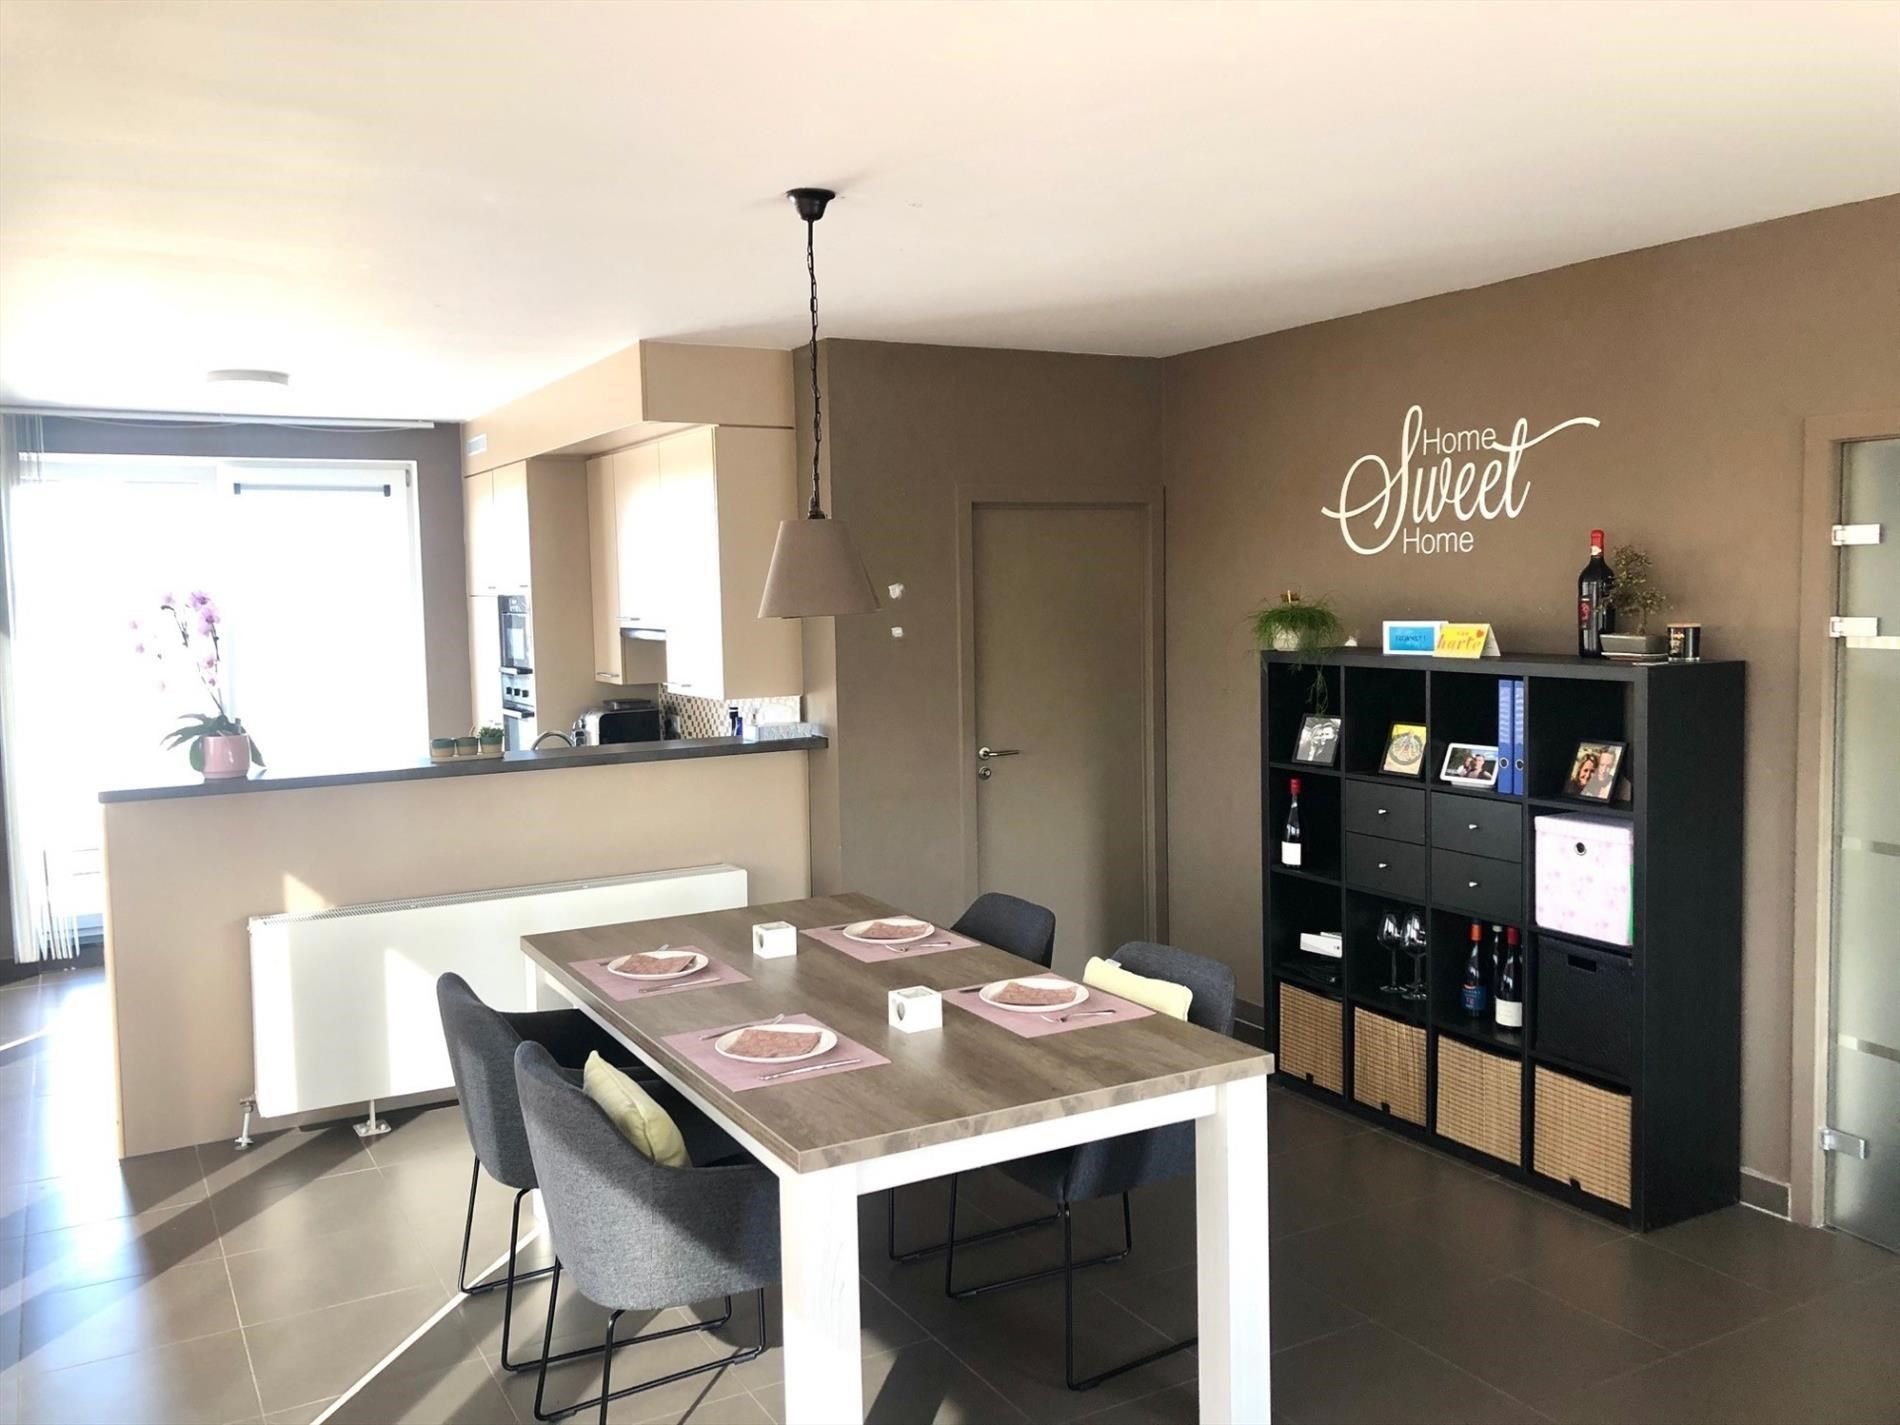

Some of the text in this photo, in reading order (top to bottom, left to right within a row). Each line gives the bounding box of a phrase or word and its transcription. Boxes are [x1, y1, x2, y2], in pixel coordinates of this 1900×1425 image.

[1423, 428, 1496, 456] Home
[1321, 405, 1600, 555] Sweet
[1403, 527, 1474, 554] Home
